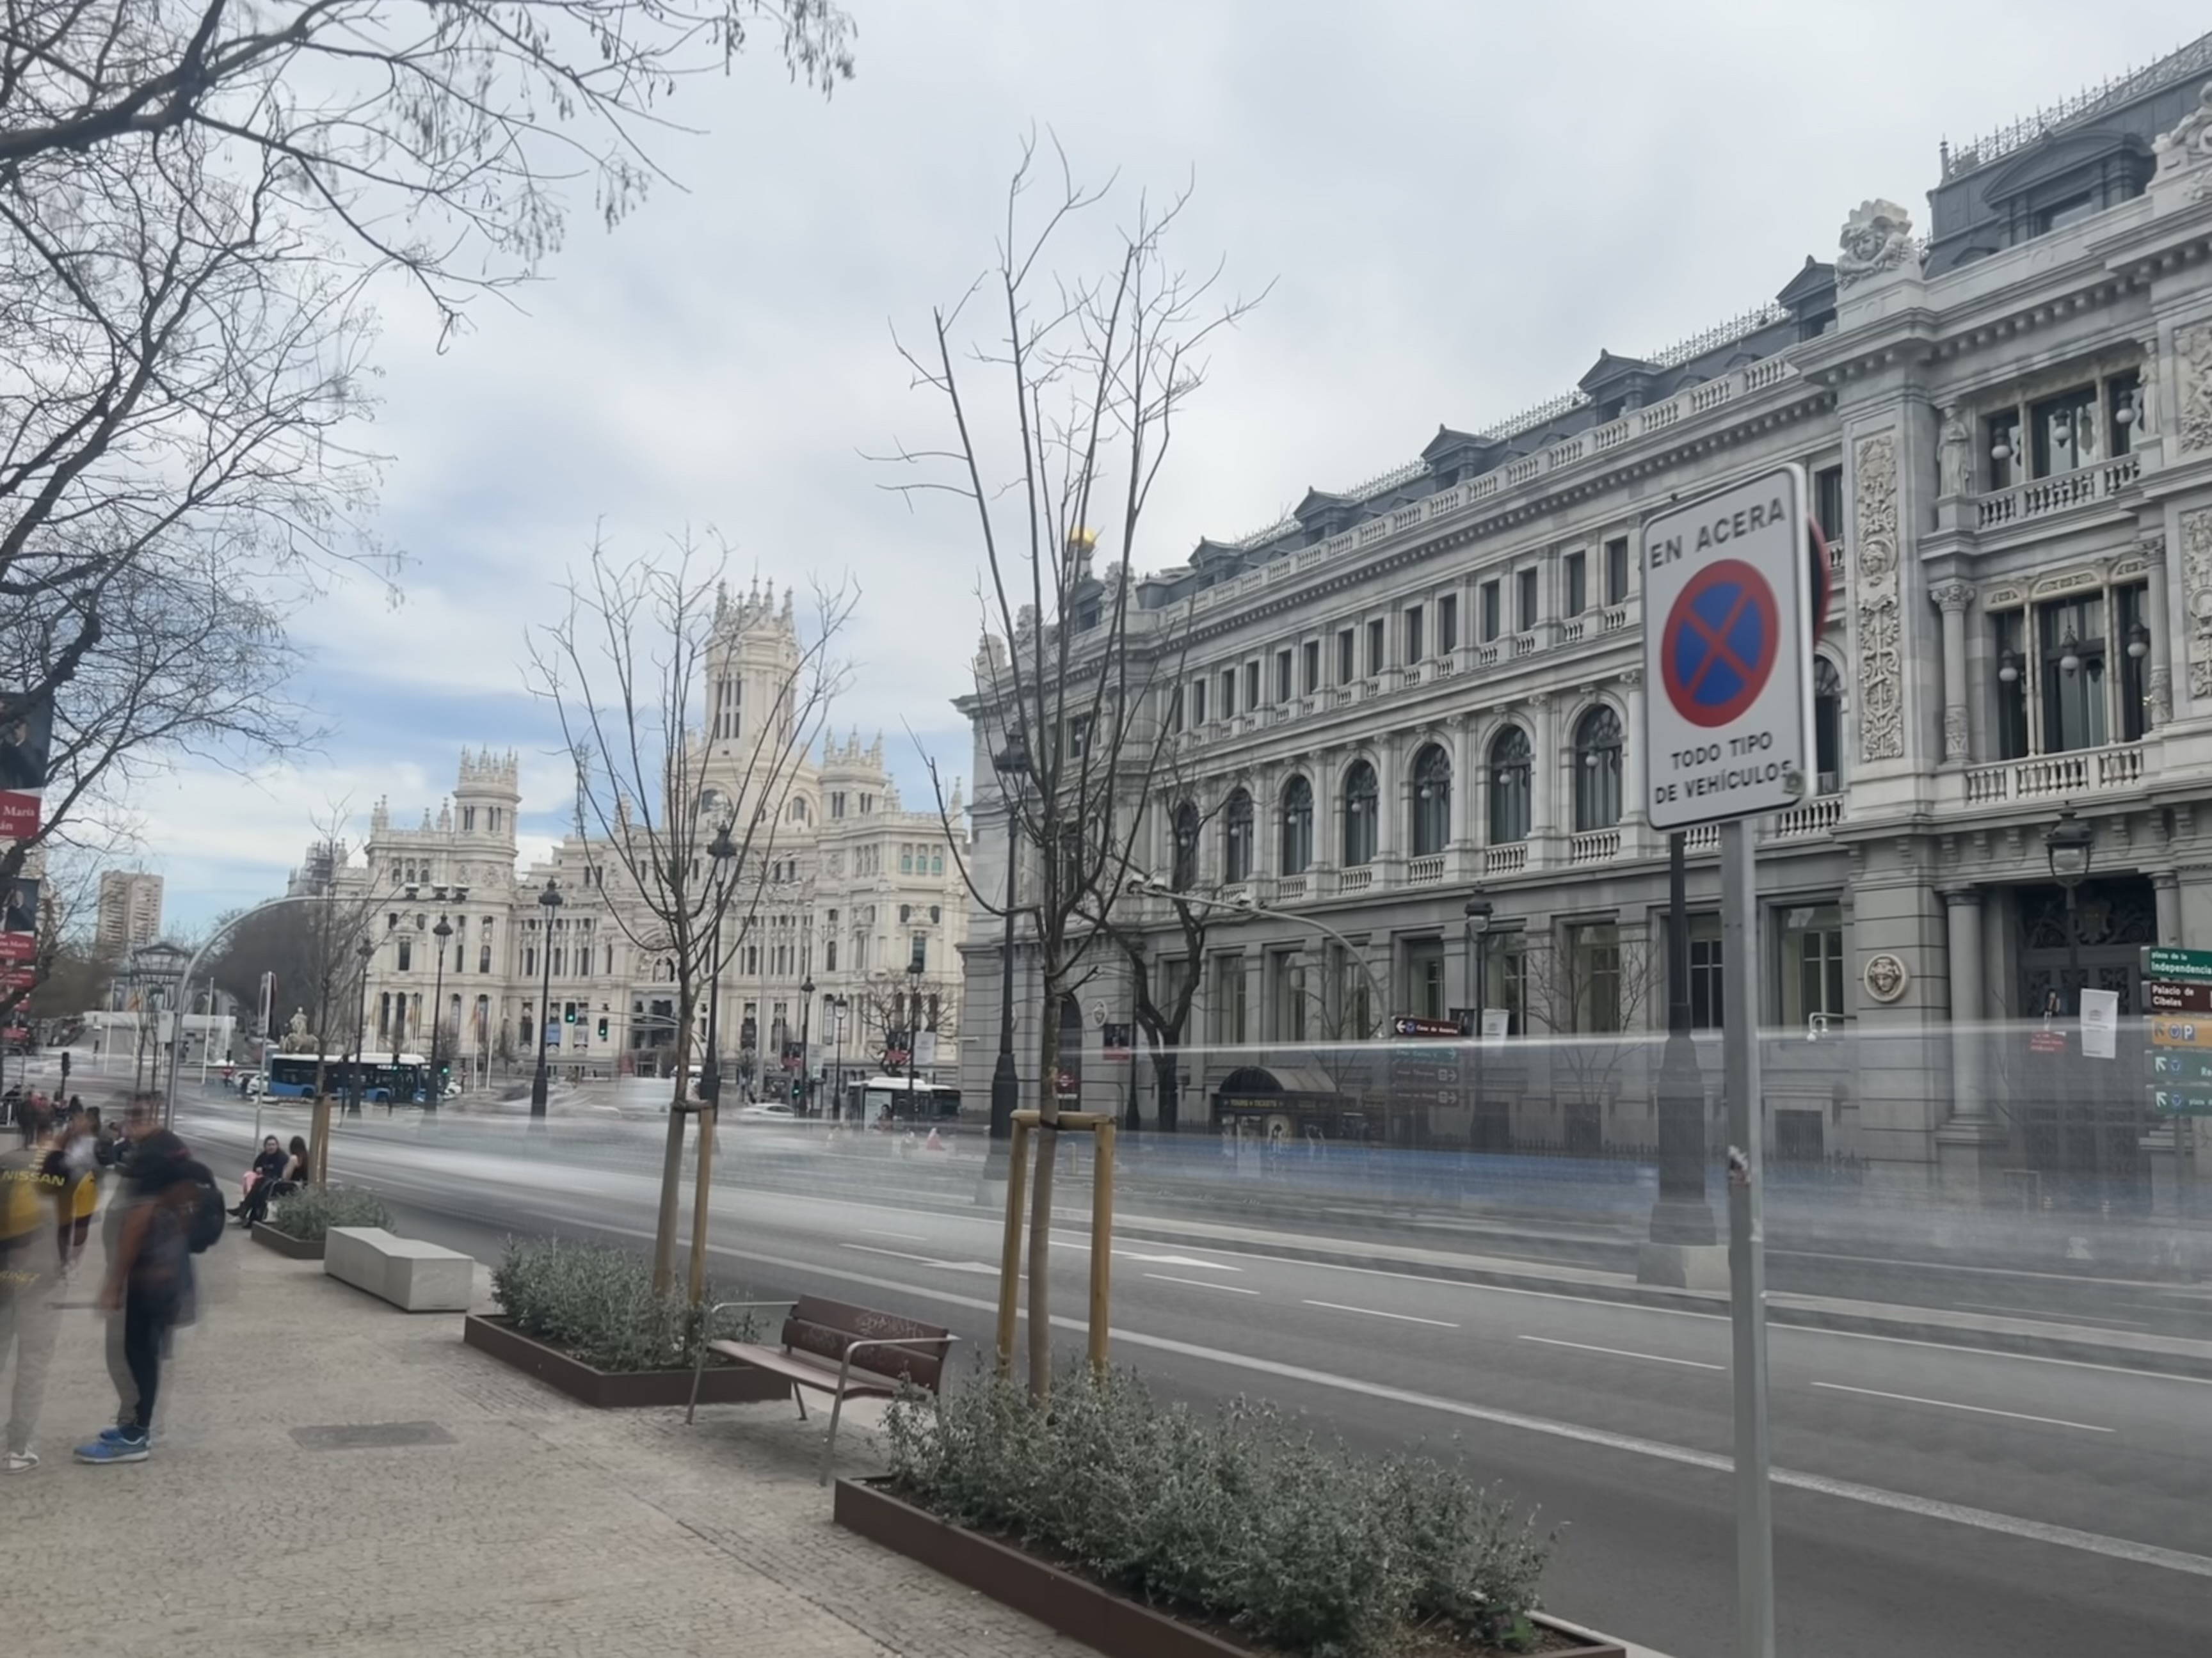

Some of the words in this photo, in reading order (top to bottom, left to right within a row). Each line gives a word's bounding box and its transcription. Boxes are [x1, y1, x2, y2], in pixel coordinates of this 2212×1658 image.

[1650, 535, 1683, 569] EN
[1695, 497, 1786, 552] ACERA
[1671, 744, 1722, 770] TODO
[1728, 731, 1773, 757] TIPO
[1655, 785, 1678, 804] DE
[2151, 961, 2212, 975] Independencia
[2152, 985, 2181, 996] Palacio
[2184, 987, 2195, 996] de
[2152, 996, 2182, 1007] Cibeles
[3, 1170, 65, 1186] NISSAN
